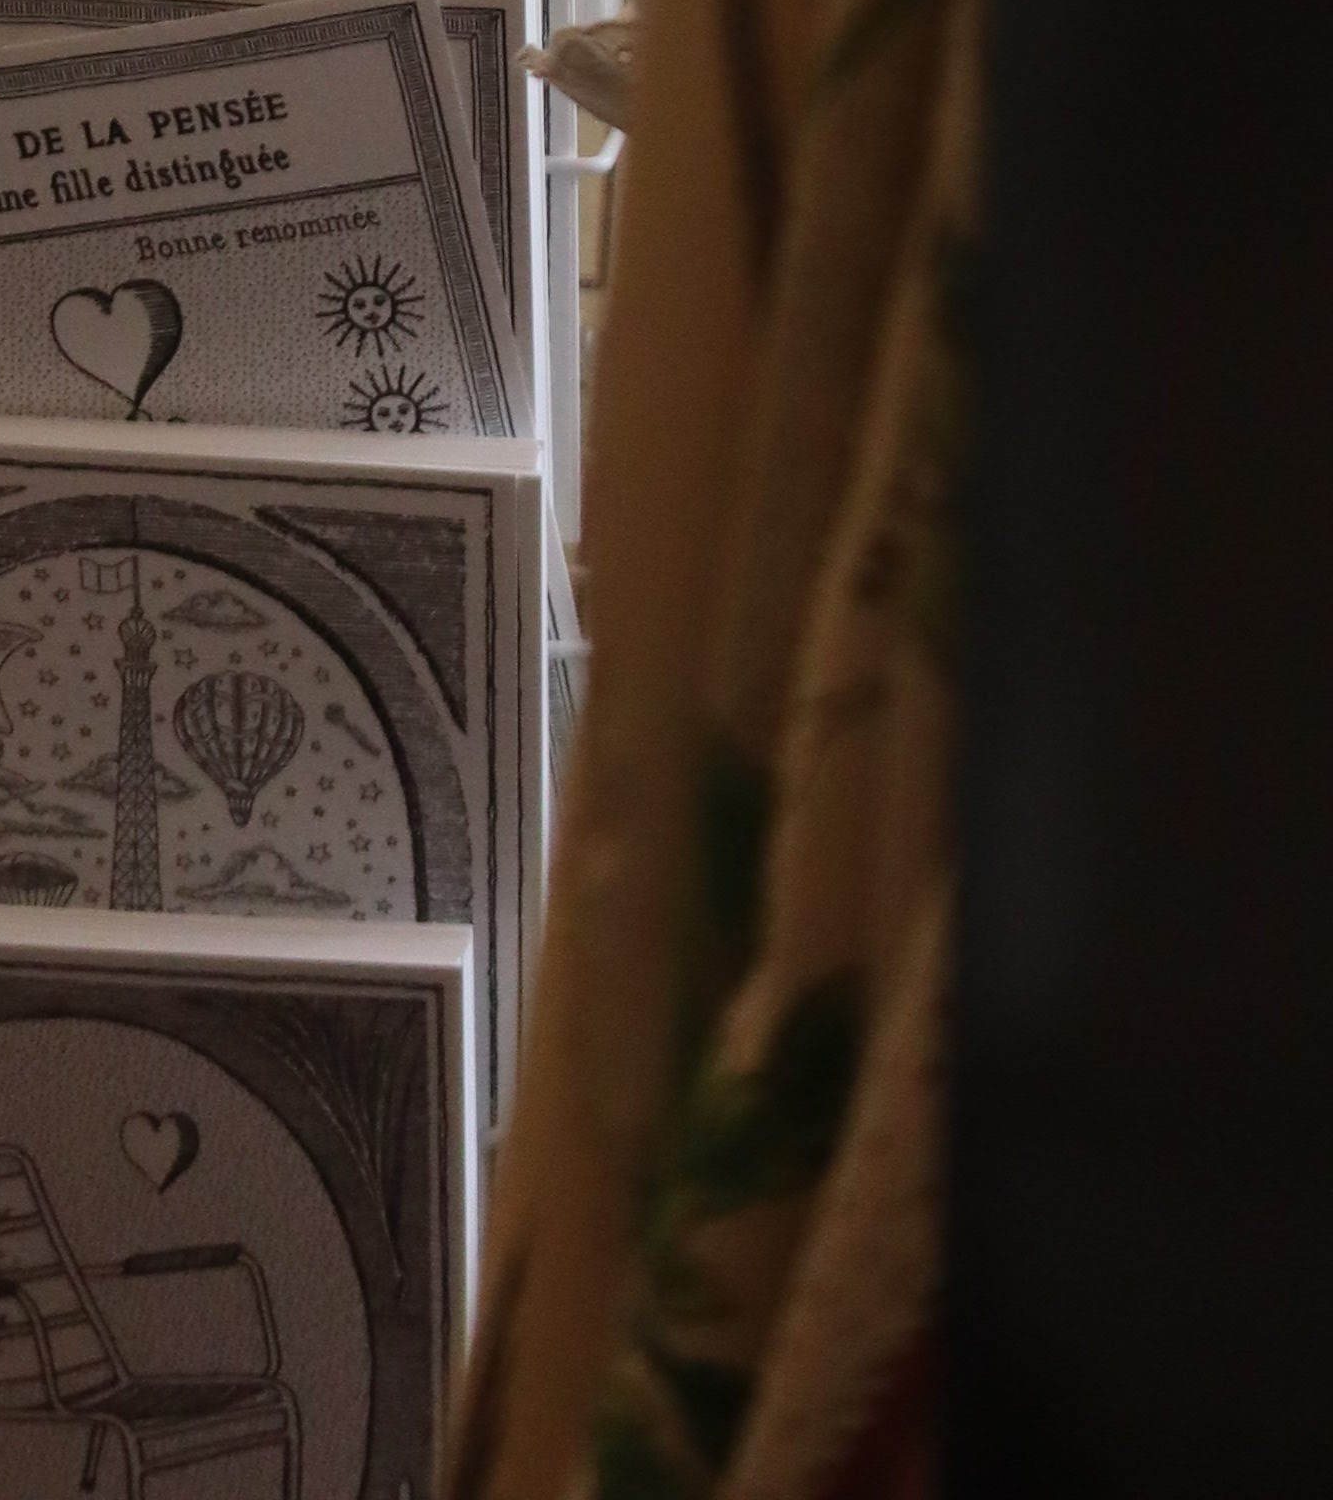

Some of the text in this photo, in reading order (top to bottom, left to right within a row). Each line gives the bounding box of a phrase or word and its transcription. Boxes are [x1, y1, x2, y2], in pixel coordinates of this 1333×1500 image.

[14, 127, 64, 159] DE
[81, 118, 132, 149] LA
[147, 90, 288, 139] PENSÉE
[51, 166, 114, 204] fille
[125, 144, 290, 192] distinguée
[134, 205, 380, 263] Bonne renommée
